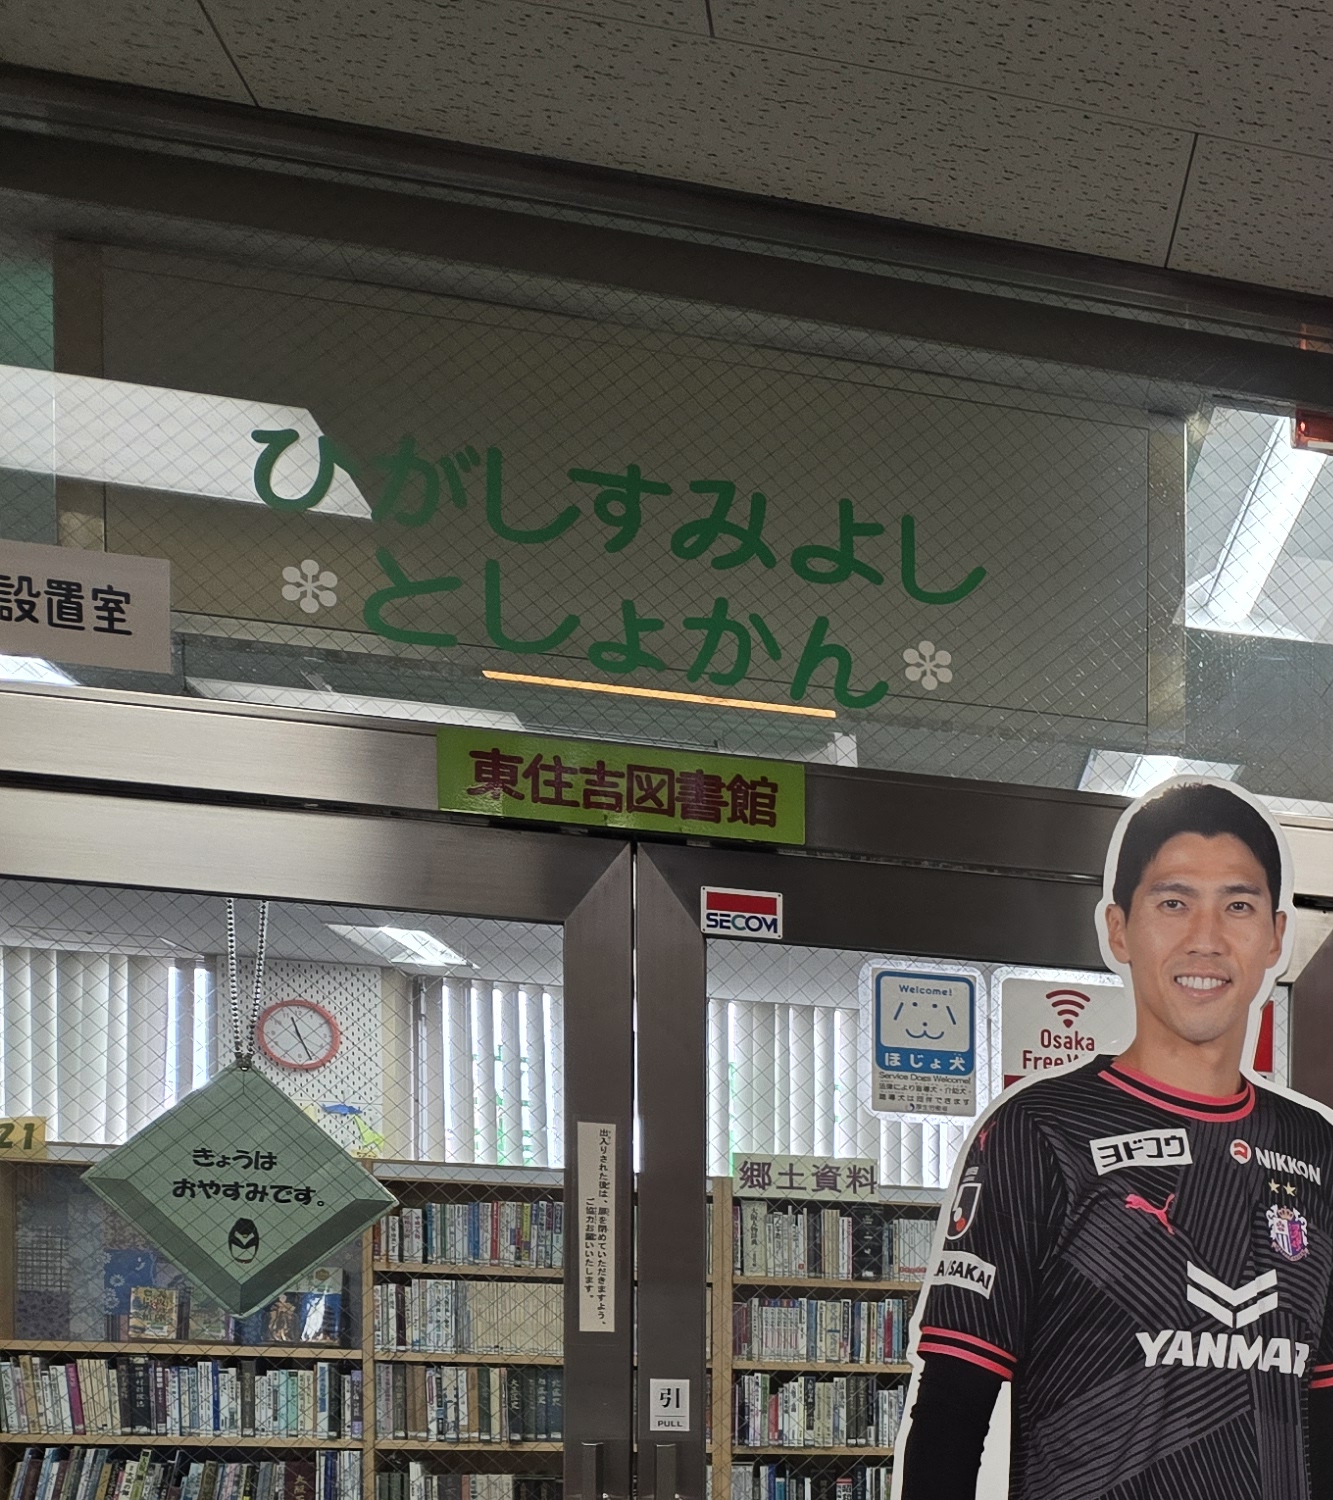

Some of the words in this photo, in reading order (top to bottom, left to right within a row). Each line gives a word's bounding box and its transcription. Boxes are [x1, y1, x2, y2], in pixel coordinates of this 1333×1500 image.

[252, 427, 986, 605] ひがしすみよし
[0, 574, 133, 636] 設置室
[363, 549, 889, 709] としょかん
[467, 748, 779, 829] 東住吉図書館
[706, 911, 778, 935] SECOM
[899, 984, 953, 997] Welcome!
[1040, 1029, 1095, 1051] Osaka
[885, 1053, 965, 1072] ほじょ犬
[192, 1147, 277, 1172] きょうは
[1097, 1136, 1187, 1169] ヨドコウ
[1255, 1147, 1321, 1185] NIKKON
[172, 1178, 325, 1207] おやすみです。
[739, 1160, 877, 1194] 郷土資料
[660, 1388, 680, 1408] 引
